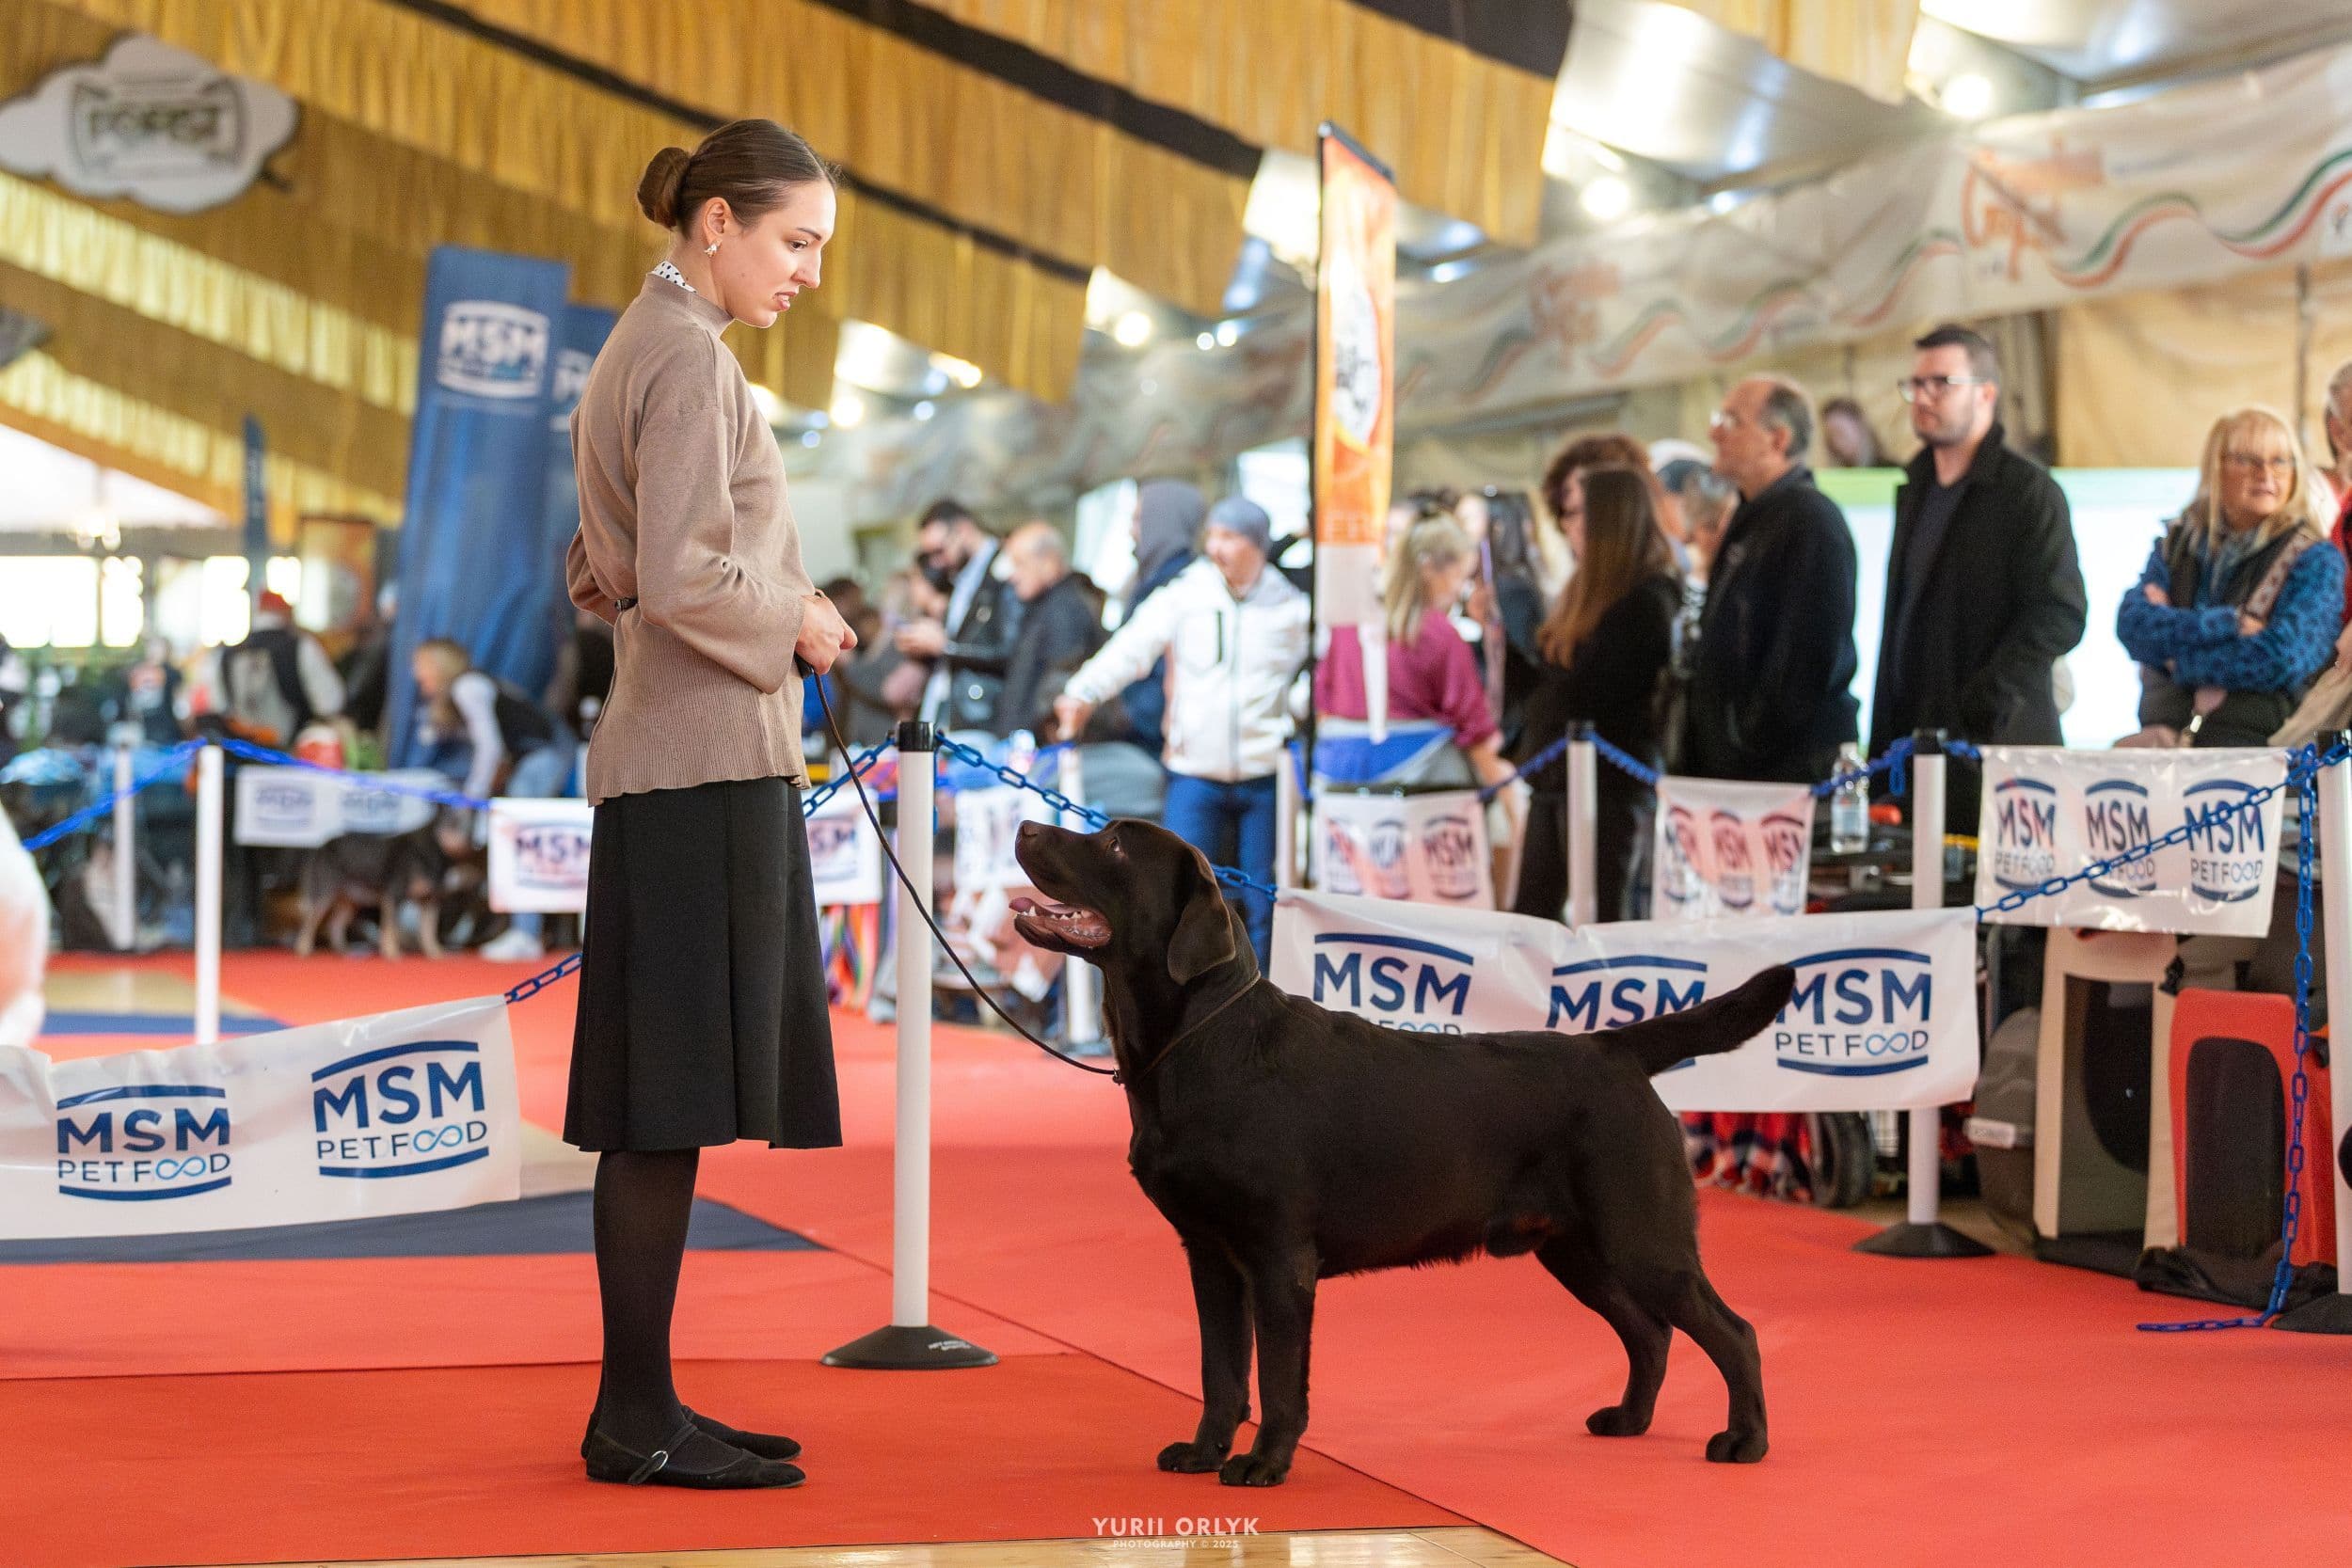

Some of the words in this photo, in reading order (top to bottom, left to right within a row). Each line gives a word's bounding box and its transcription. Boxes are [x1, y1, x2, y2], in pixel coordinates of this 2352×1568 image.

[1997, 798, 2056, 847] MSM
[2086, 800, 2152, 851] MSM
[2185, 801, 2265, 853] MSM
[2190, 858, 2218, 883] PET
[2221, 859, 2263, 883] FOOD
[1313, 952, 1471, 1015] MSM
[1546, 978, 1706, 1031] MSM
[1775, 968, 1931, 1024] MSM
[1776, 1032, 1836, 1056] PET
[1845, 1030, 1929, 1056] FOOD
[313, 1061, 485, 1132] MSM
[57, 1107, 230, 1153] MSM
[317, 1135, 382, 1159] PET
[390, 1120, 487, 1157] FOOD
[58, 1159, 124, 1182] PET
[134, 1153, 230, 1182] FOOD
